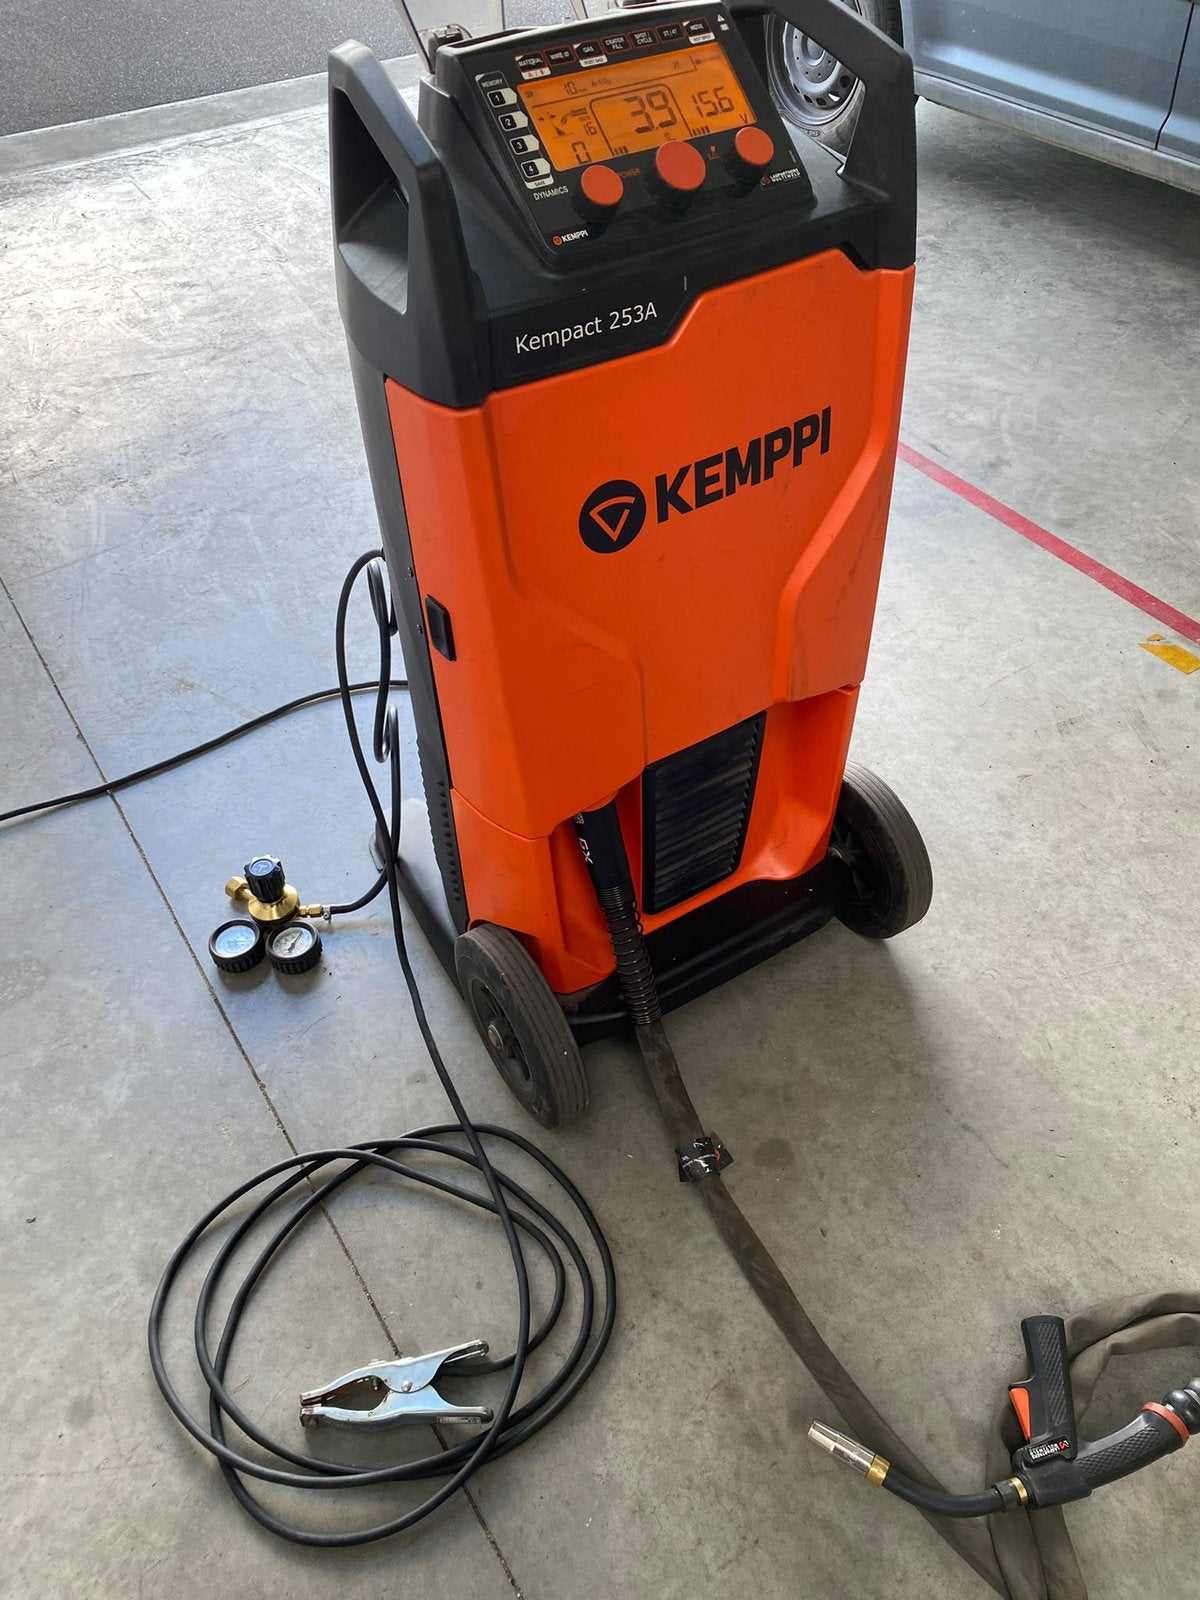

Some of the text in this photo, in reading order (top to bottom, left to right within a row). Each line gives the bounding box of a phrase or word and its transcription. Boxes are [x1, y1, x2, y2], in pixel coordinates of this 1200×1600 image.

[481, 78, 503, 88] MEMORY
[533, 185, 569, 201] DYNAMICS
[561, 229, 589, 242] KEMPPI
[515, 302, 658, 354] Kempact 253A
[655, 406, 832, 524] KEMPPI
